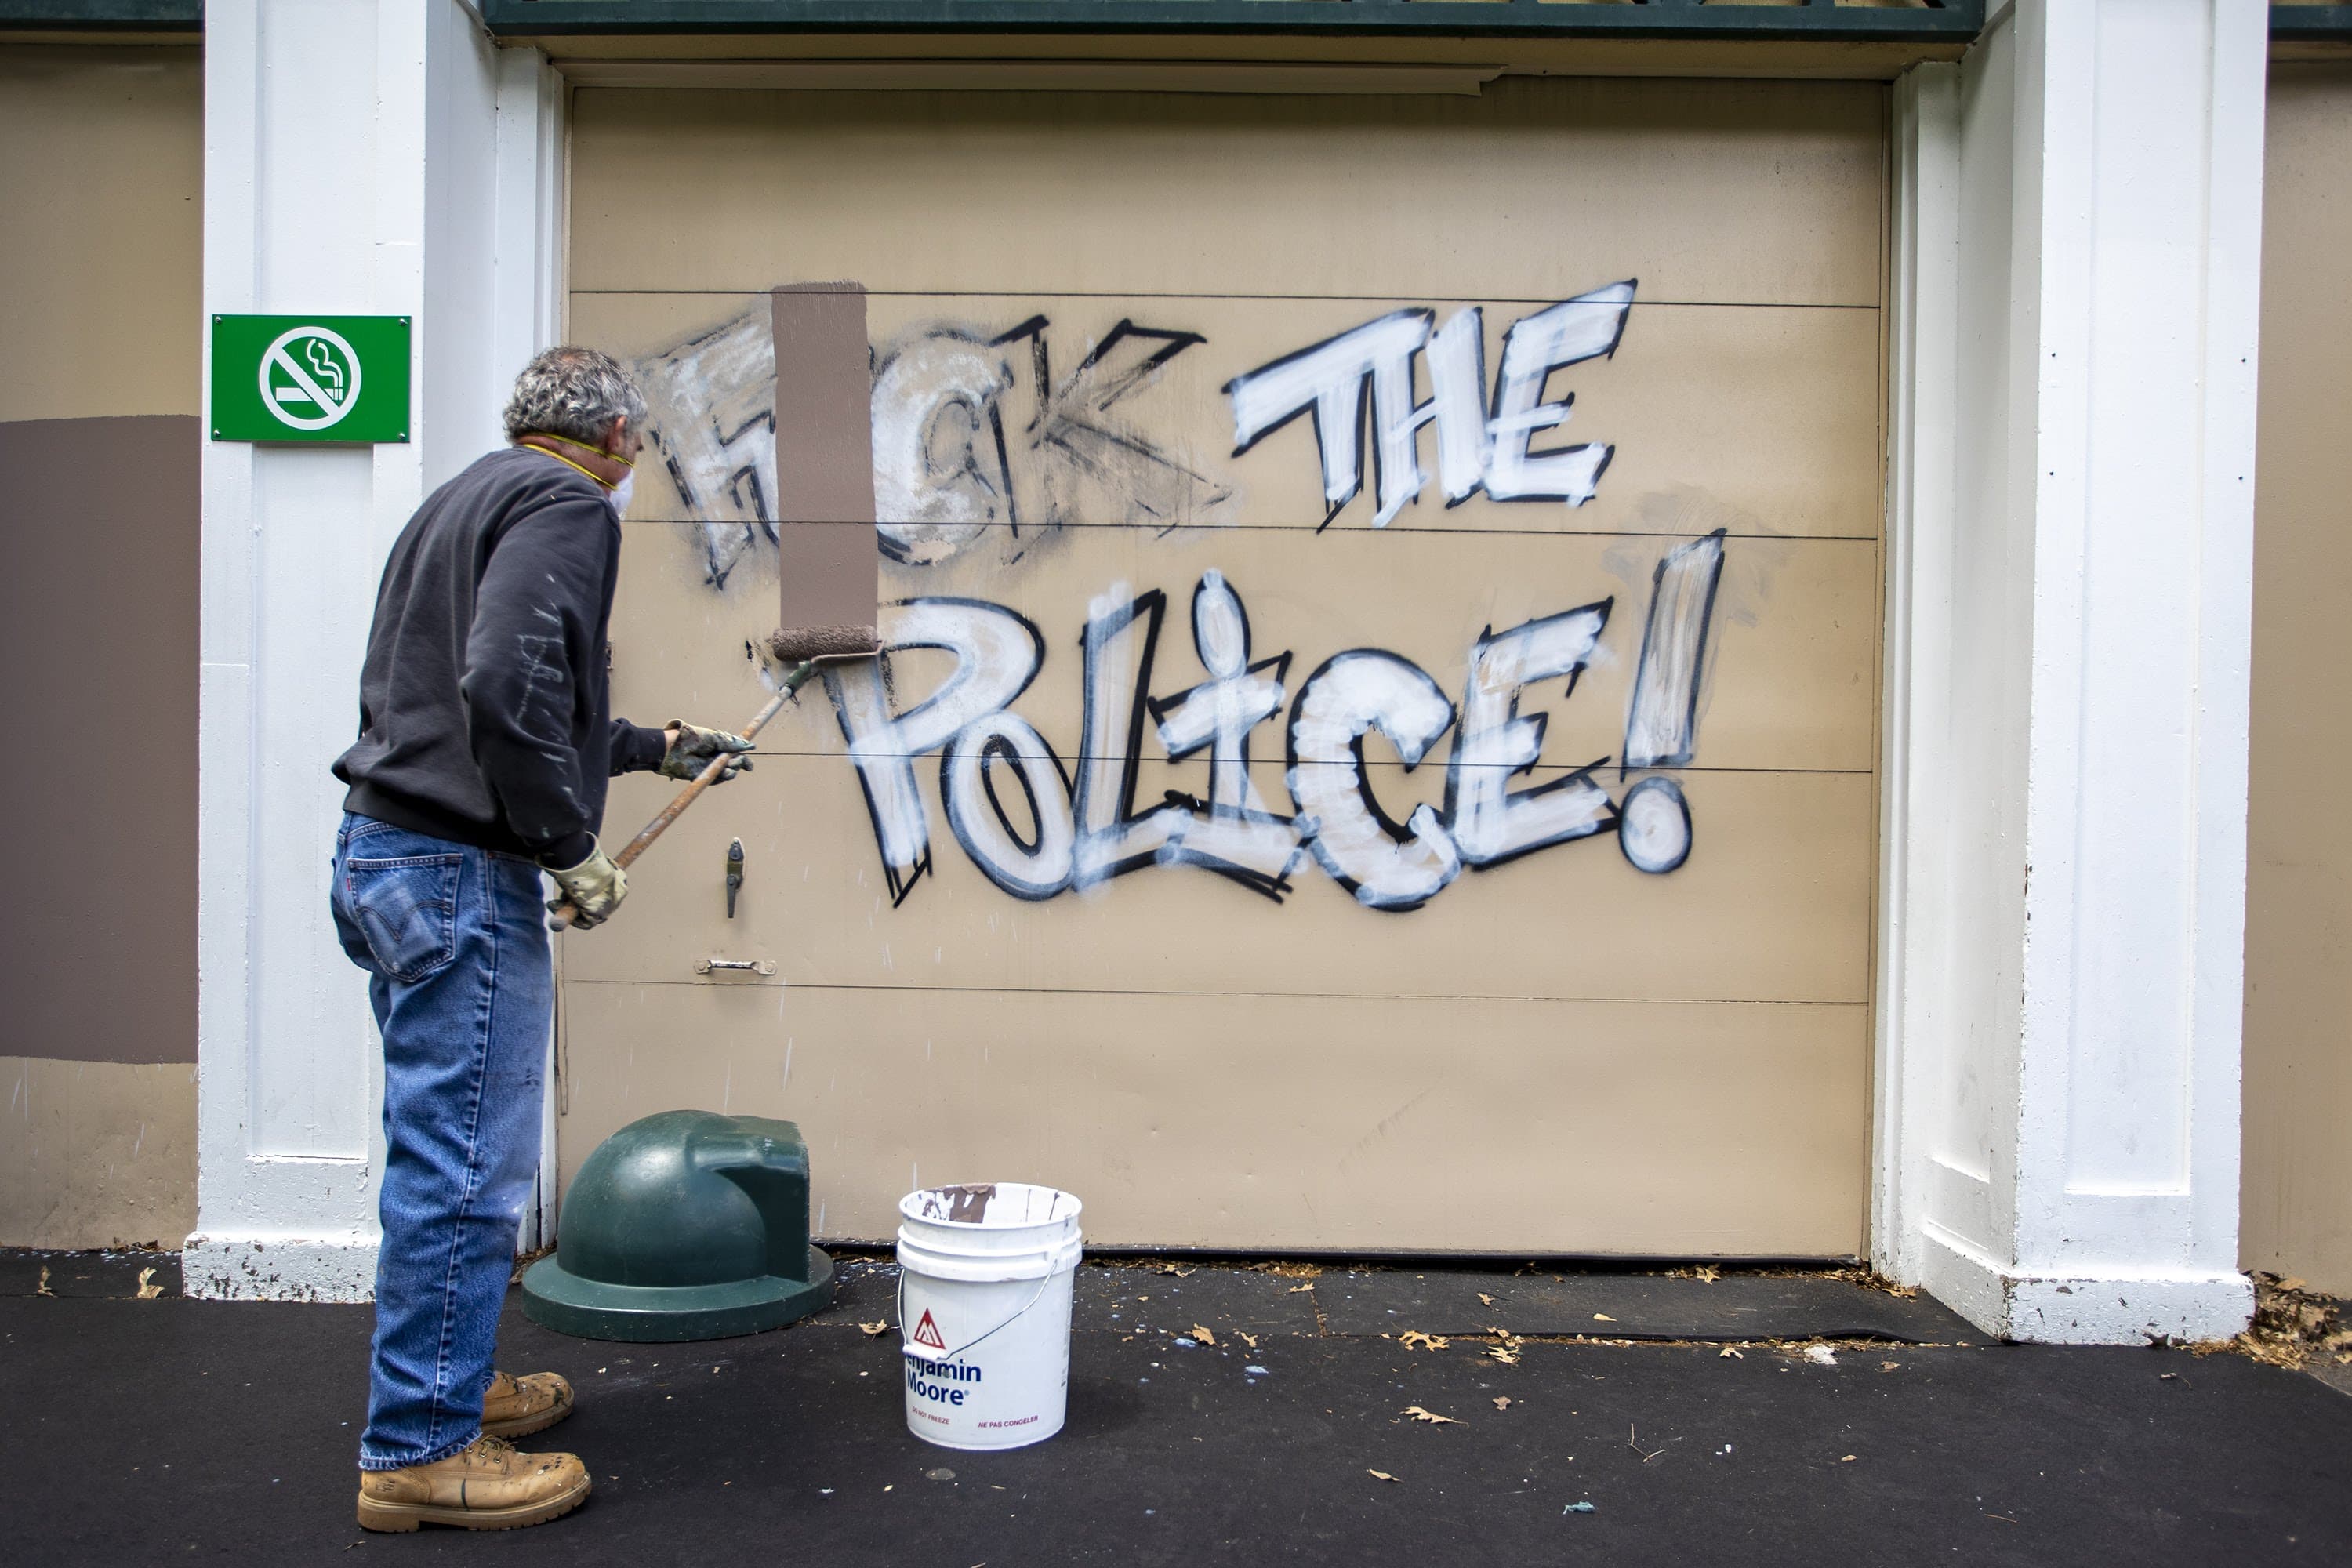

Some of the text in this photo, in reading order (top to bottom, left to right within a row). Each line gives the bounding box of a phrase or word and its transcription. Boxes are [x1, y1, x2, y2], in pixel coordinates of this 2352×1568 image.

[635, 278, 1638, 590] FCK THE
[905, 1354, 982, 1382] enjamin
[907, 1367, 964, 1406] Moore
[927, 1414, 949, 1425] FREEZE
[1004, 1415, 1039, 1427] CONGELER
